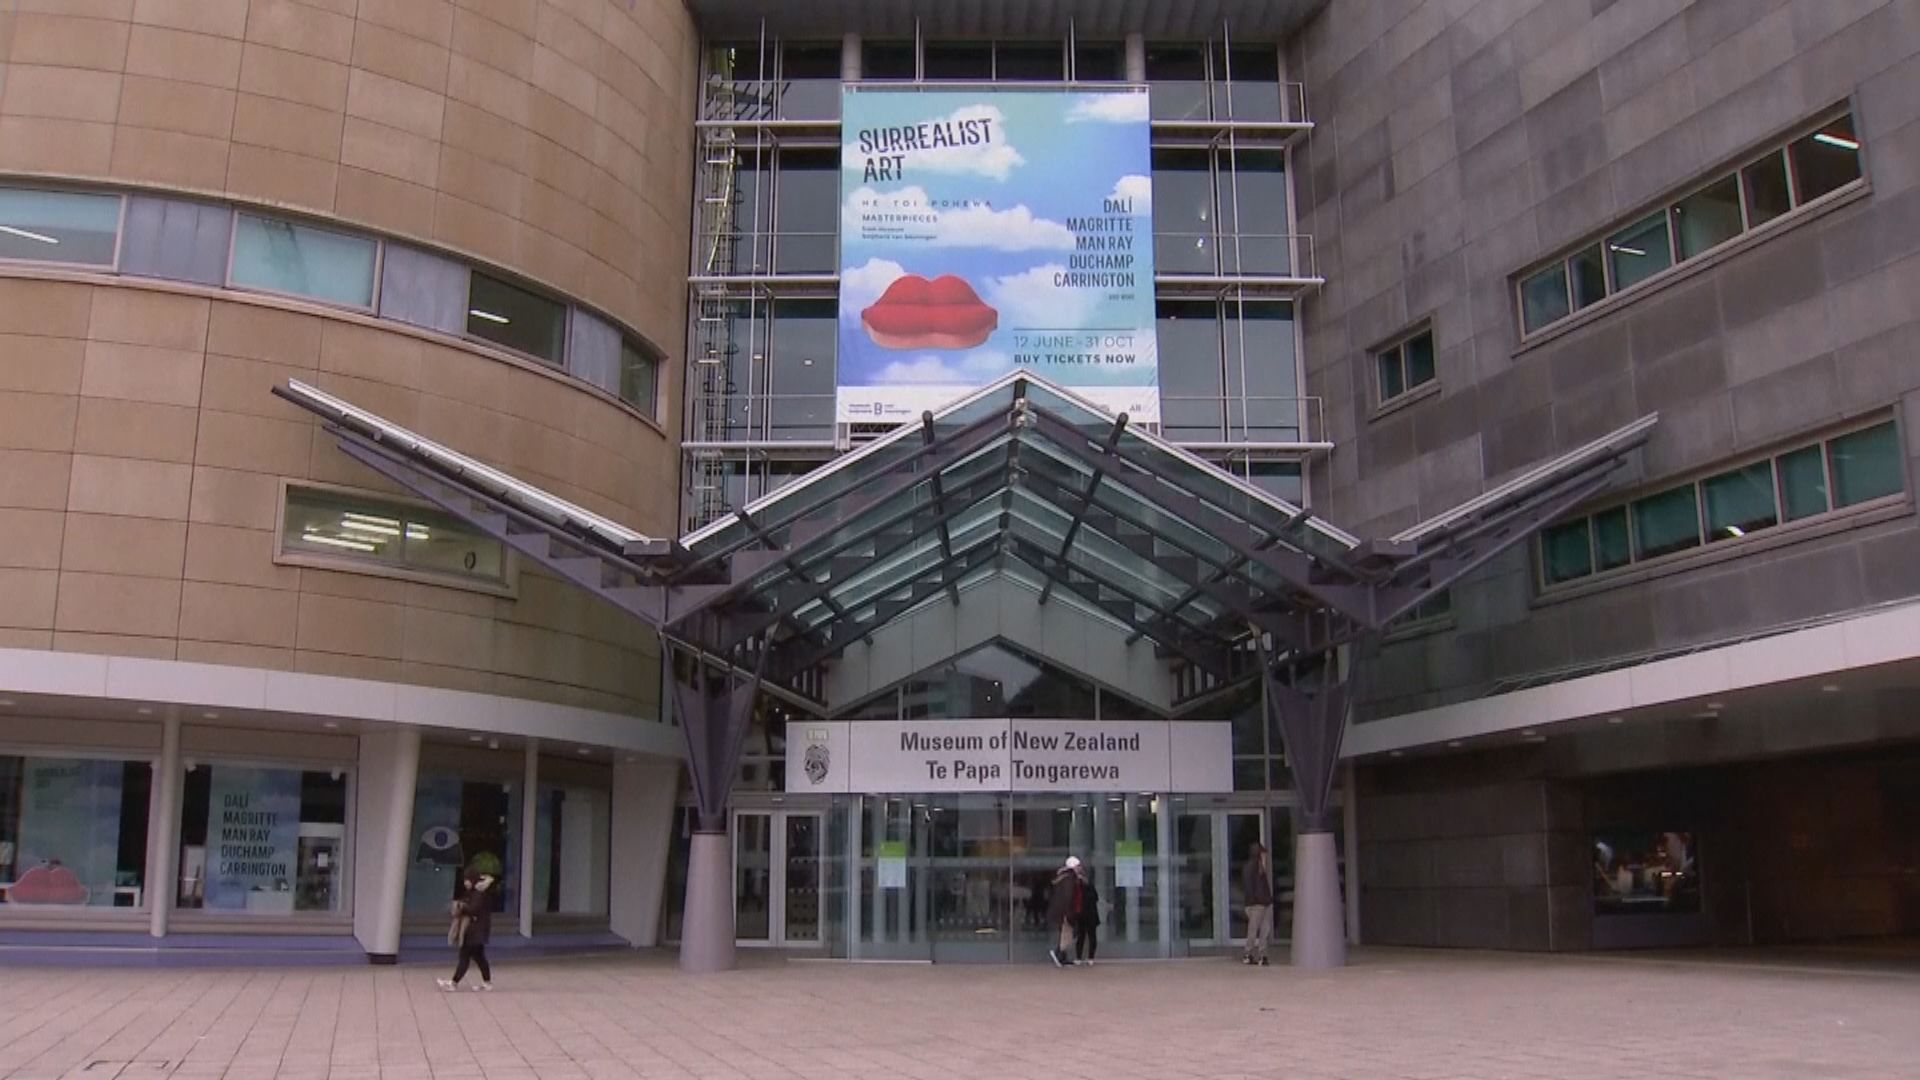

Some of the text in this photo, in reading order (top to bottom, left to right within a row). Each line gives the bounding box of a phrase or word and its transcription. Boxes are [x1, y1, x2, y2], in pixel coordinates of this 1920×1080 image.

[859, 118, 992, 154] SURREALIST
[863, 155, 905, 183] ART
[1103, 196, 1133, 213] DALÍ
[862, 214, 938, 222] MASTERPIECES
[1066, 218, 1133, 231] MAGRITTE
[1076, 236, 1133, 250] MAN RAY
[1069, 254, 1134, 269] DUCHAMP
[1053, 272, 1135, 287] CARRINGTON
[1014, 336, 1028, 348] 12
[1033, 336, 1073, 348] JUNE
[1086, 336, 1099, 348] 31
[1104, 336, 1135, 348] OCT
[1014, 354, 1136, 363] BUY TICKETS NOW
[901, 731, 1140, 751] Museum of New Zealand
[926, 760, 1120, 783] Te Papa Tongarewa
[223, 811, 277, 826] MAGRITTE
[222, 828, 270, 842] MAN RAY
[221, 844, 275, 859] DUCHAMP
[220, 862, 287, 876] CARRINGTON
